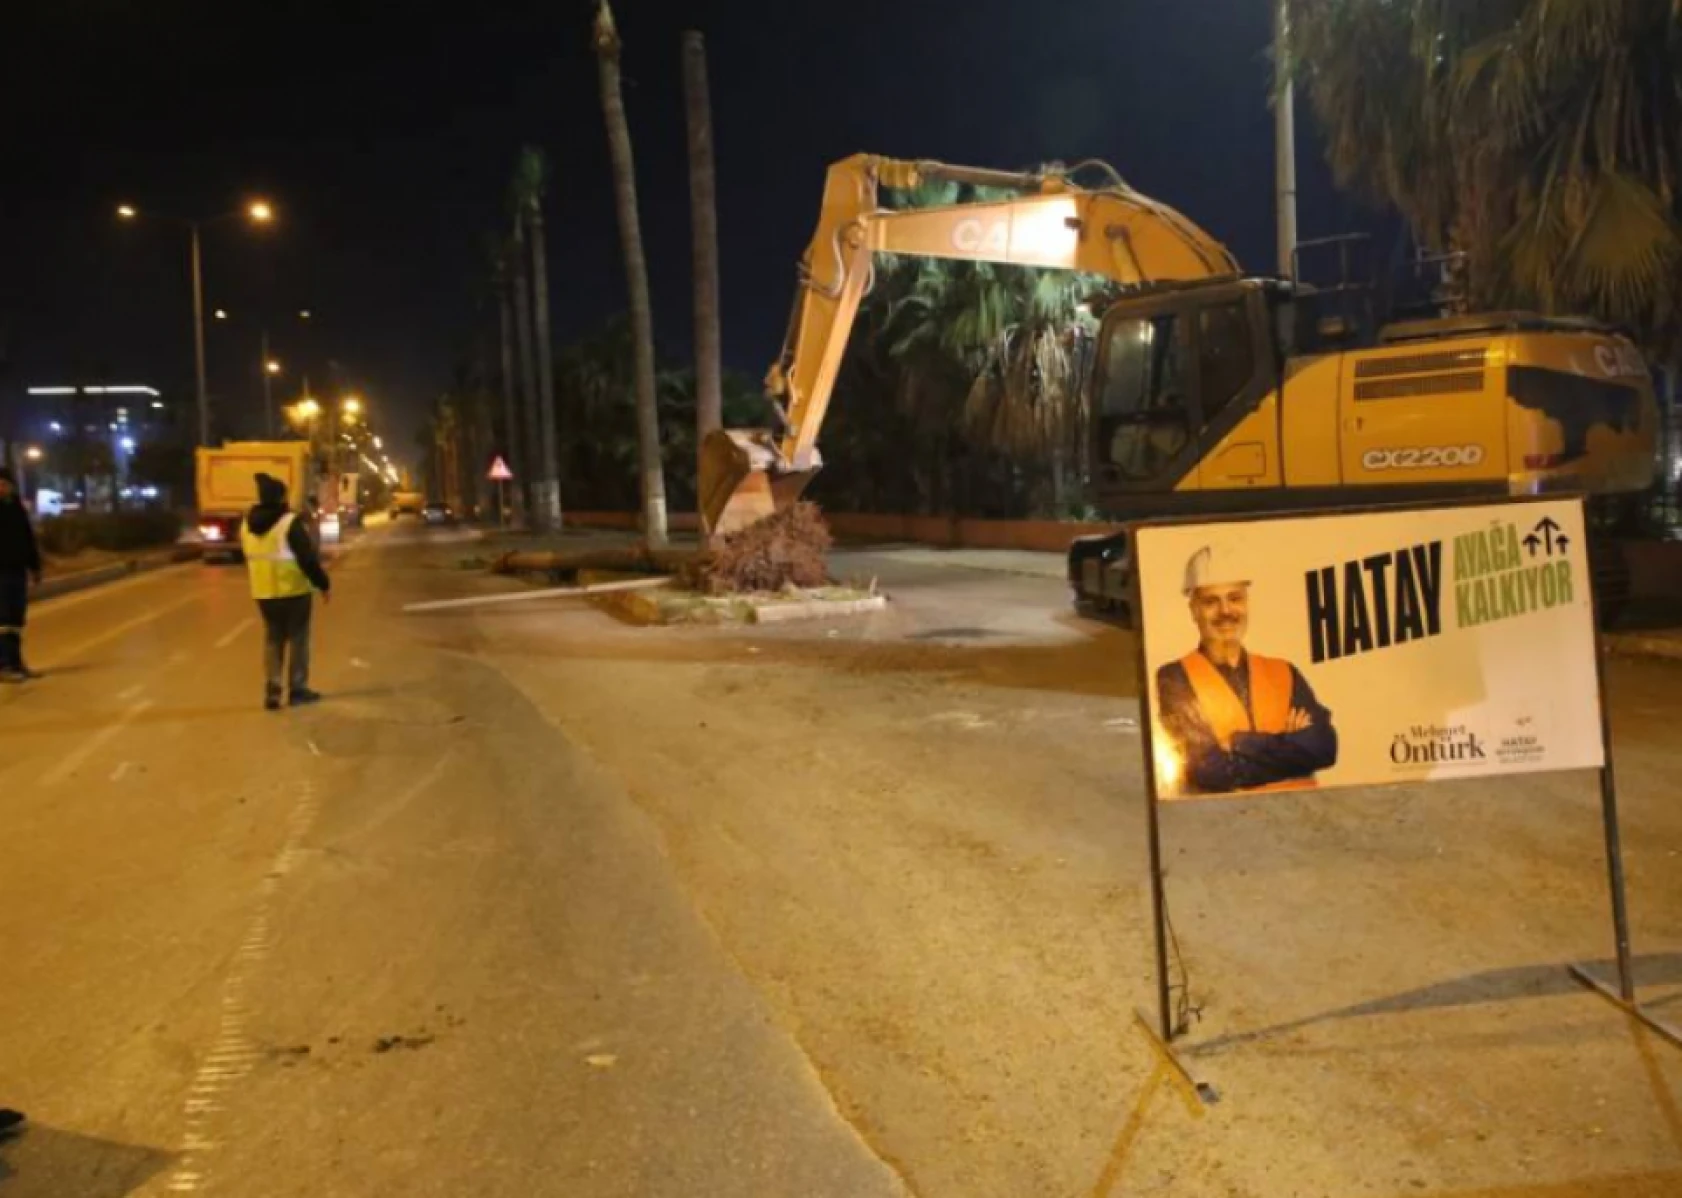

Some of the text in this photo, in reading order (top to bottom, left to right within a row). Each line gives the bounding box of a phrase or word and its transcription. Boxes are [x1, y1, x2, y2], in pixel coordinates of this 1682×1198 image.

[1454, 519, 1521, 581] AYAĞA
[1304, 540, 1442, 664] HATAY
[1455, 559, 1573, 628] KALKIYOR
[1390, 732, 1485, 763] Öntürk
